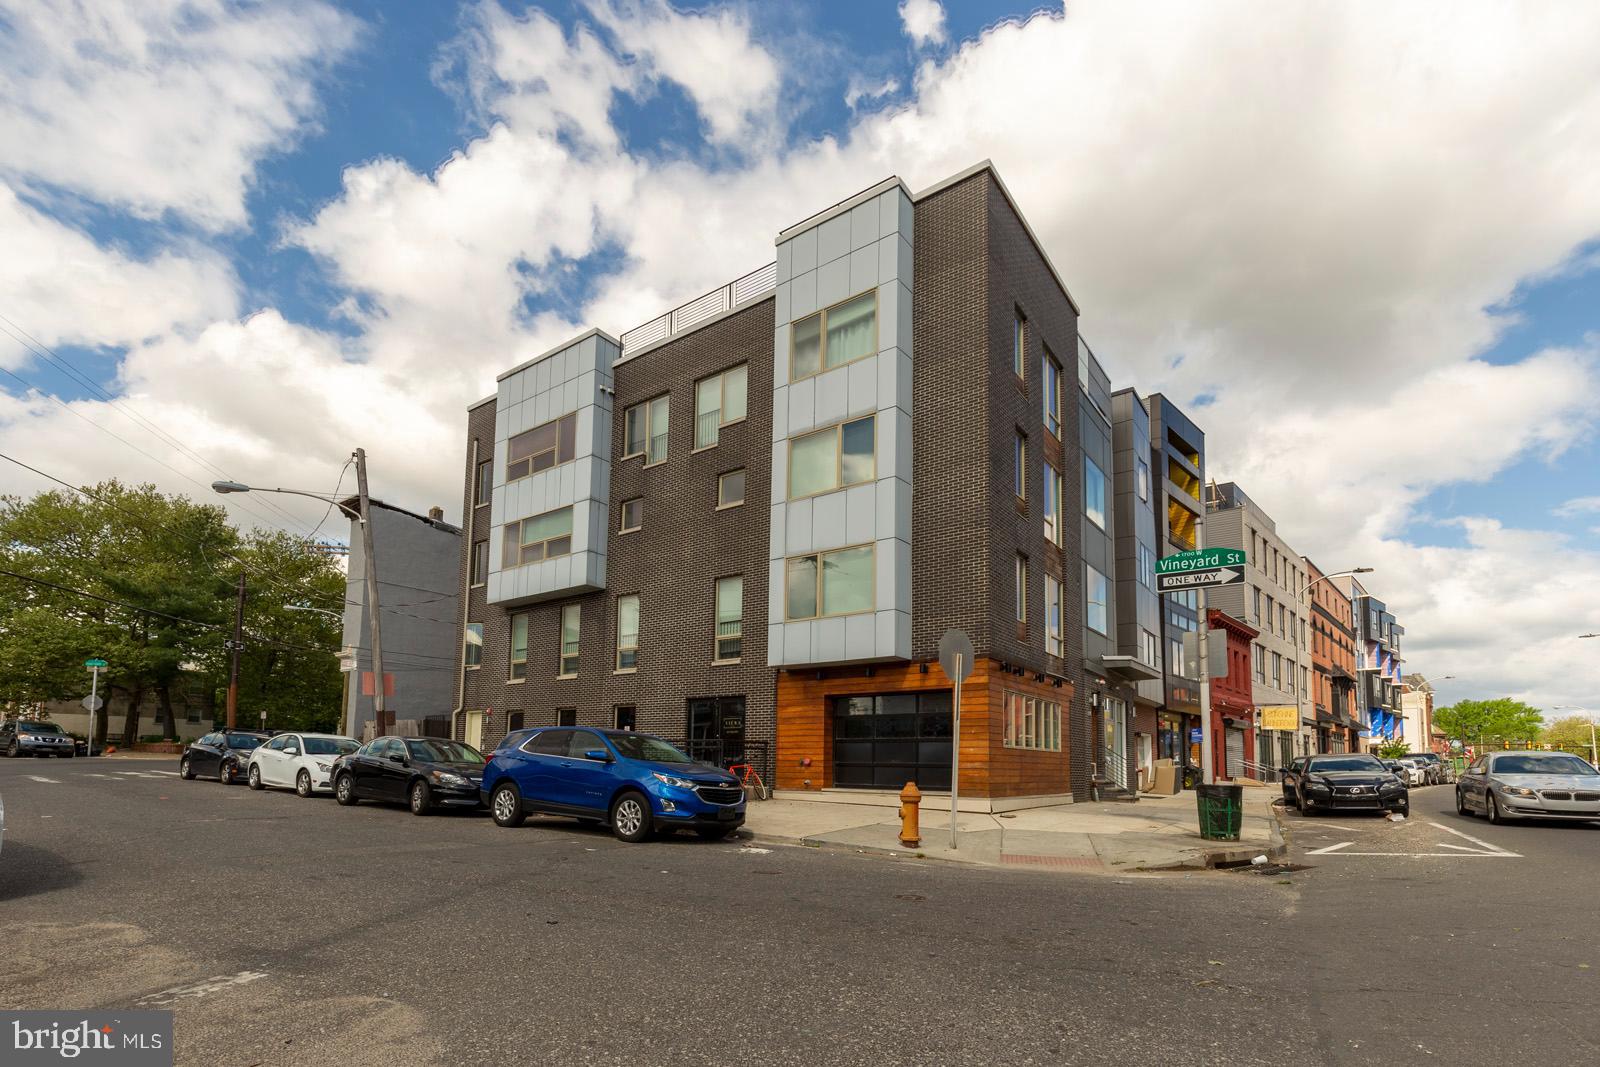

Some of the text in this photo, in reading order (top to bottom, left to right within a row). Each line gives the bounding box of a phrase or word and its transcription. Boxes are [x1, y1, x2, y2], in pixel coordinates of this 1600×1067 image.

[1160, 553, 1240, 571] Vineyard St
[1167, 572, 1218, 586] ONE WAY
